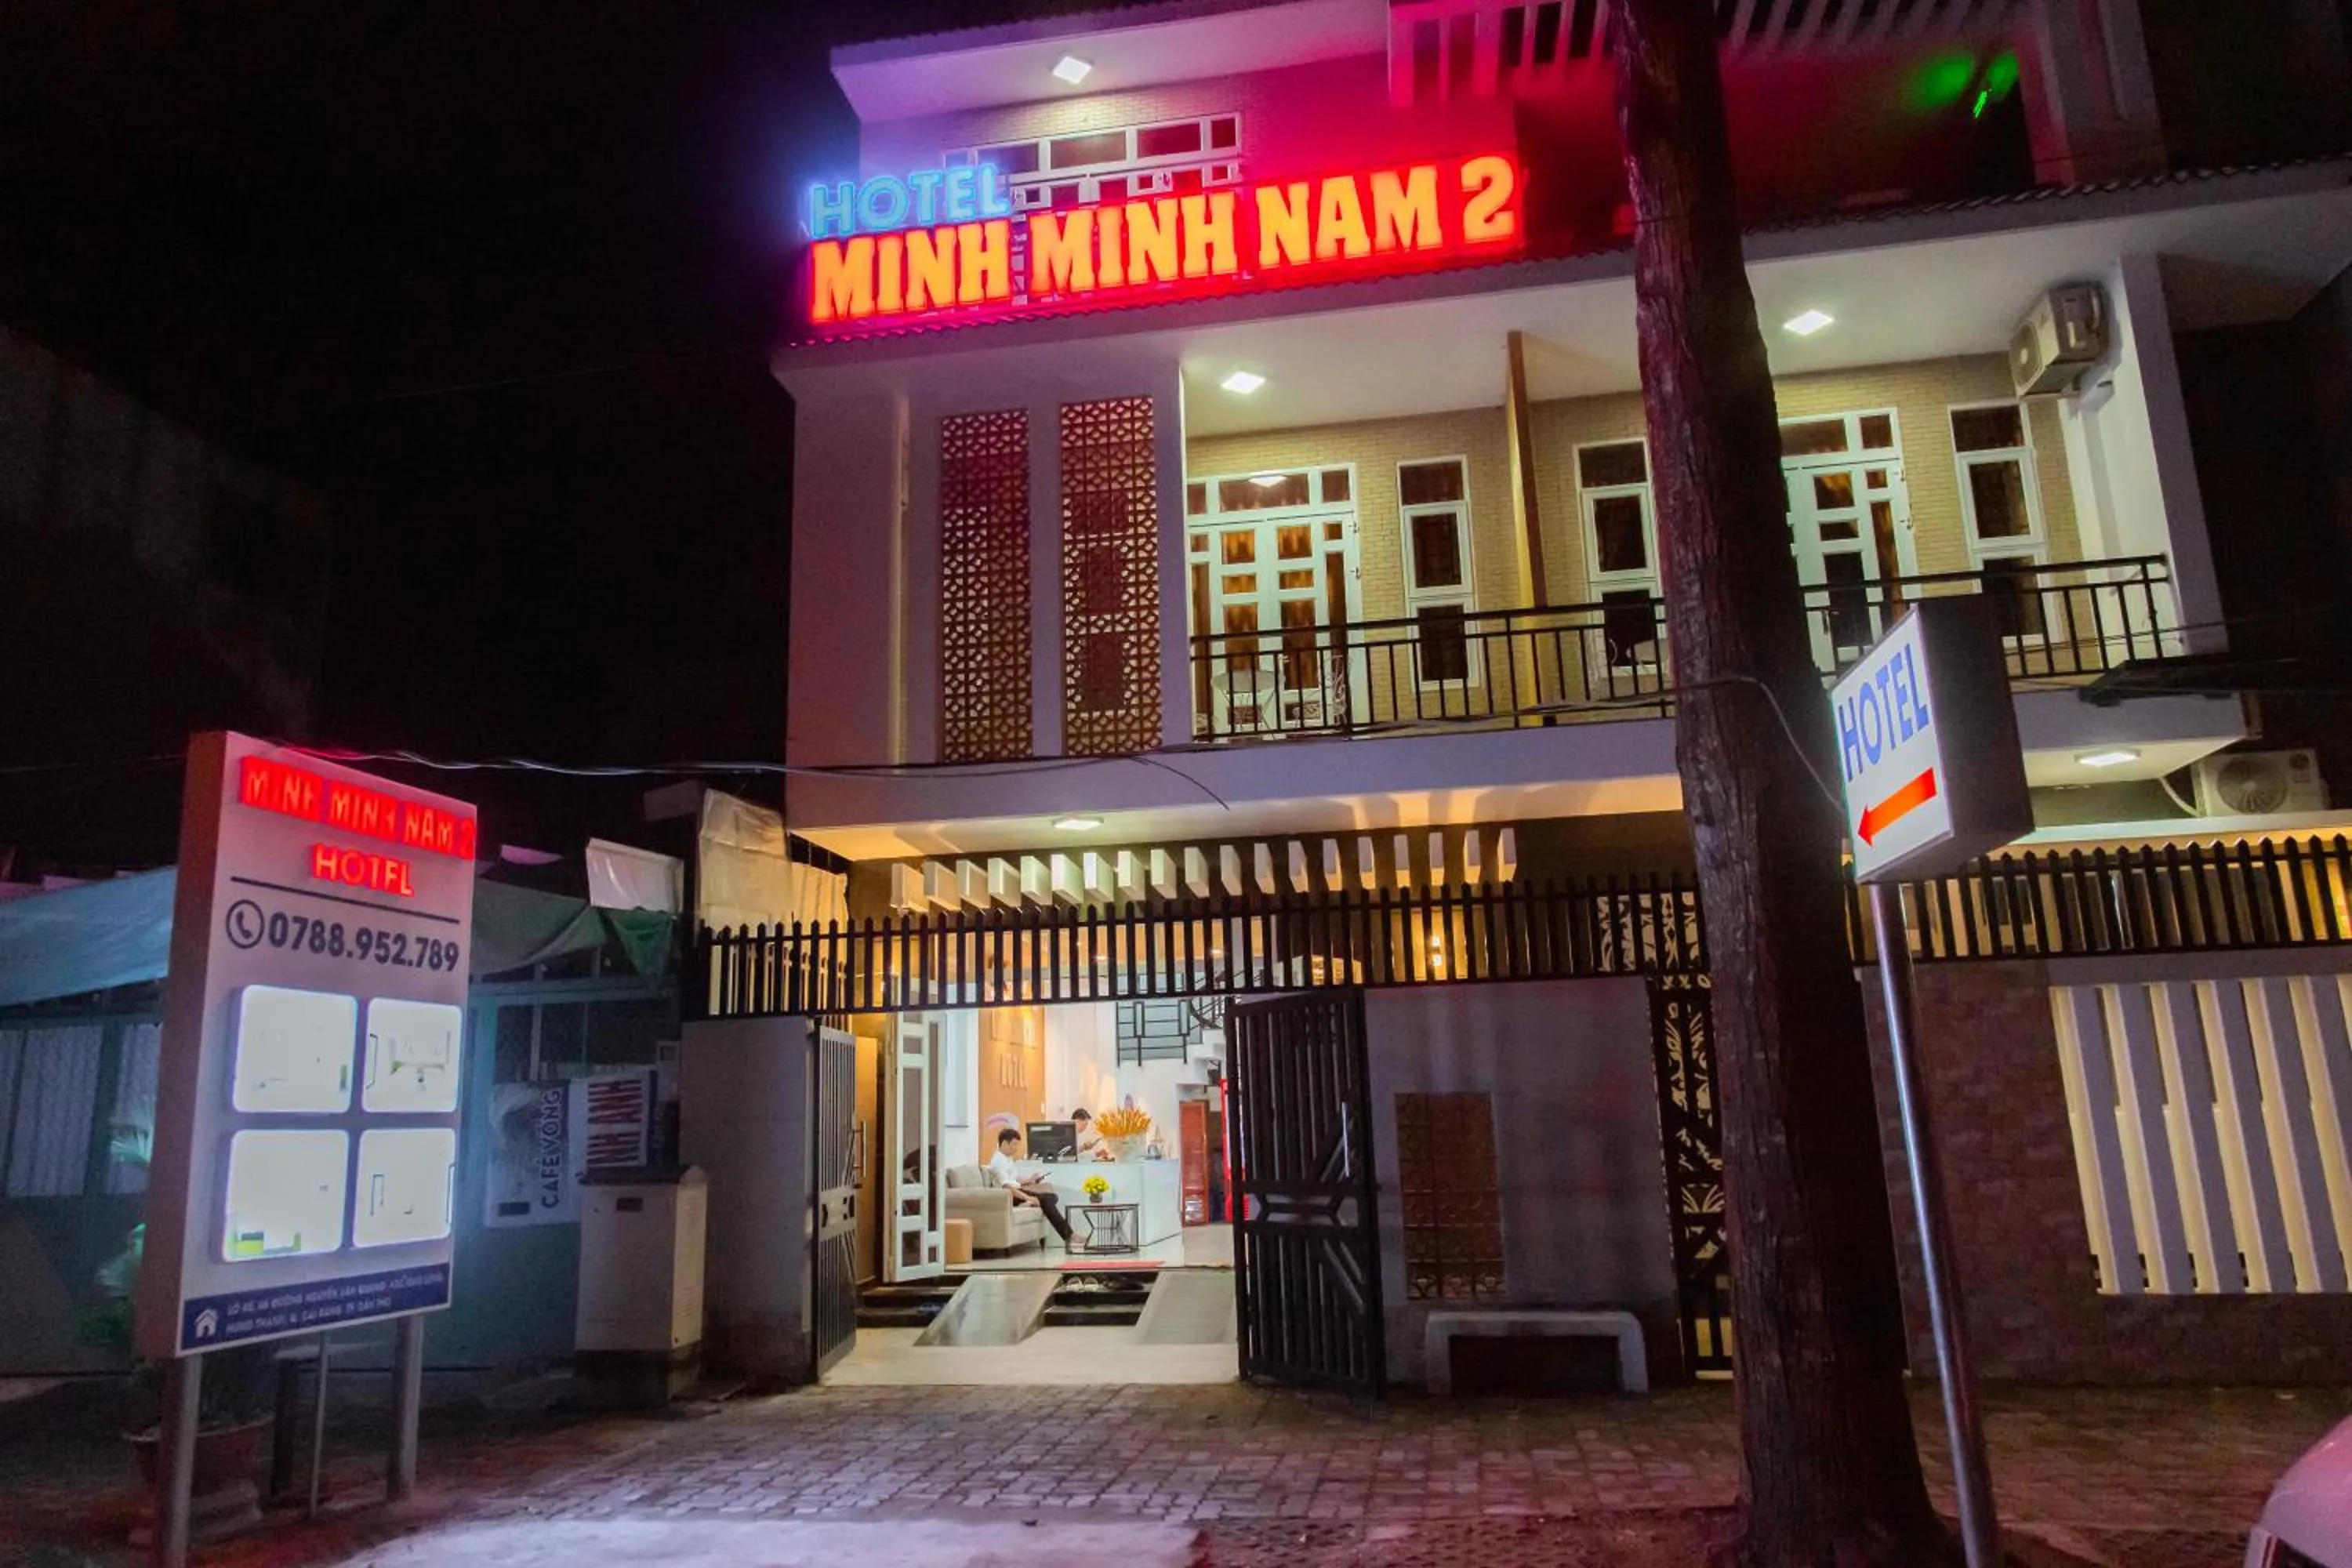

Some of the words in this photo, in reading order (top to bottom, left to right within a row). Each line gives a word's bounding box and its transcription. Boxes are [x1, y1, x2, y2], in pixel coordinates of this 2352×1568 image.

[811, 164, 1010, 238] HOTEL
[811, 219, 1010, 323] MINH
[1029, 191, 1237, 296] MINH
[1255, 165, 1443, 270] NAM
[1461, 156, 1514, 244] 2
[1838, 643, 1929, 782] HOTEL
[405, 802, 456, 855] NAM
[314, 844, 414, 896] HOTEL
[268, 912, 459, 971] 0788.952.789
